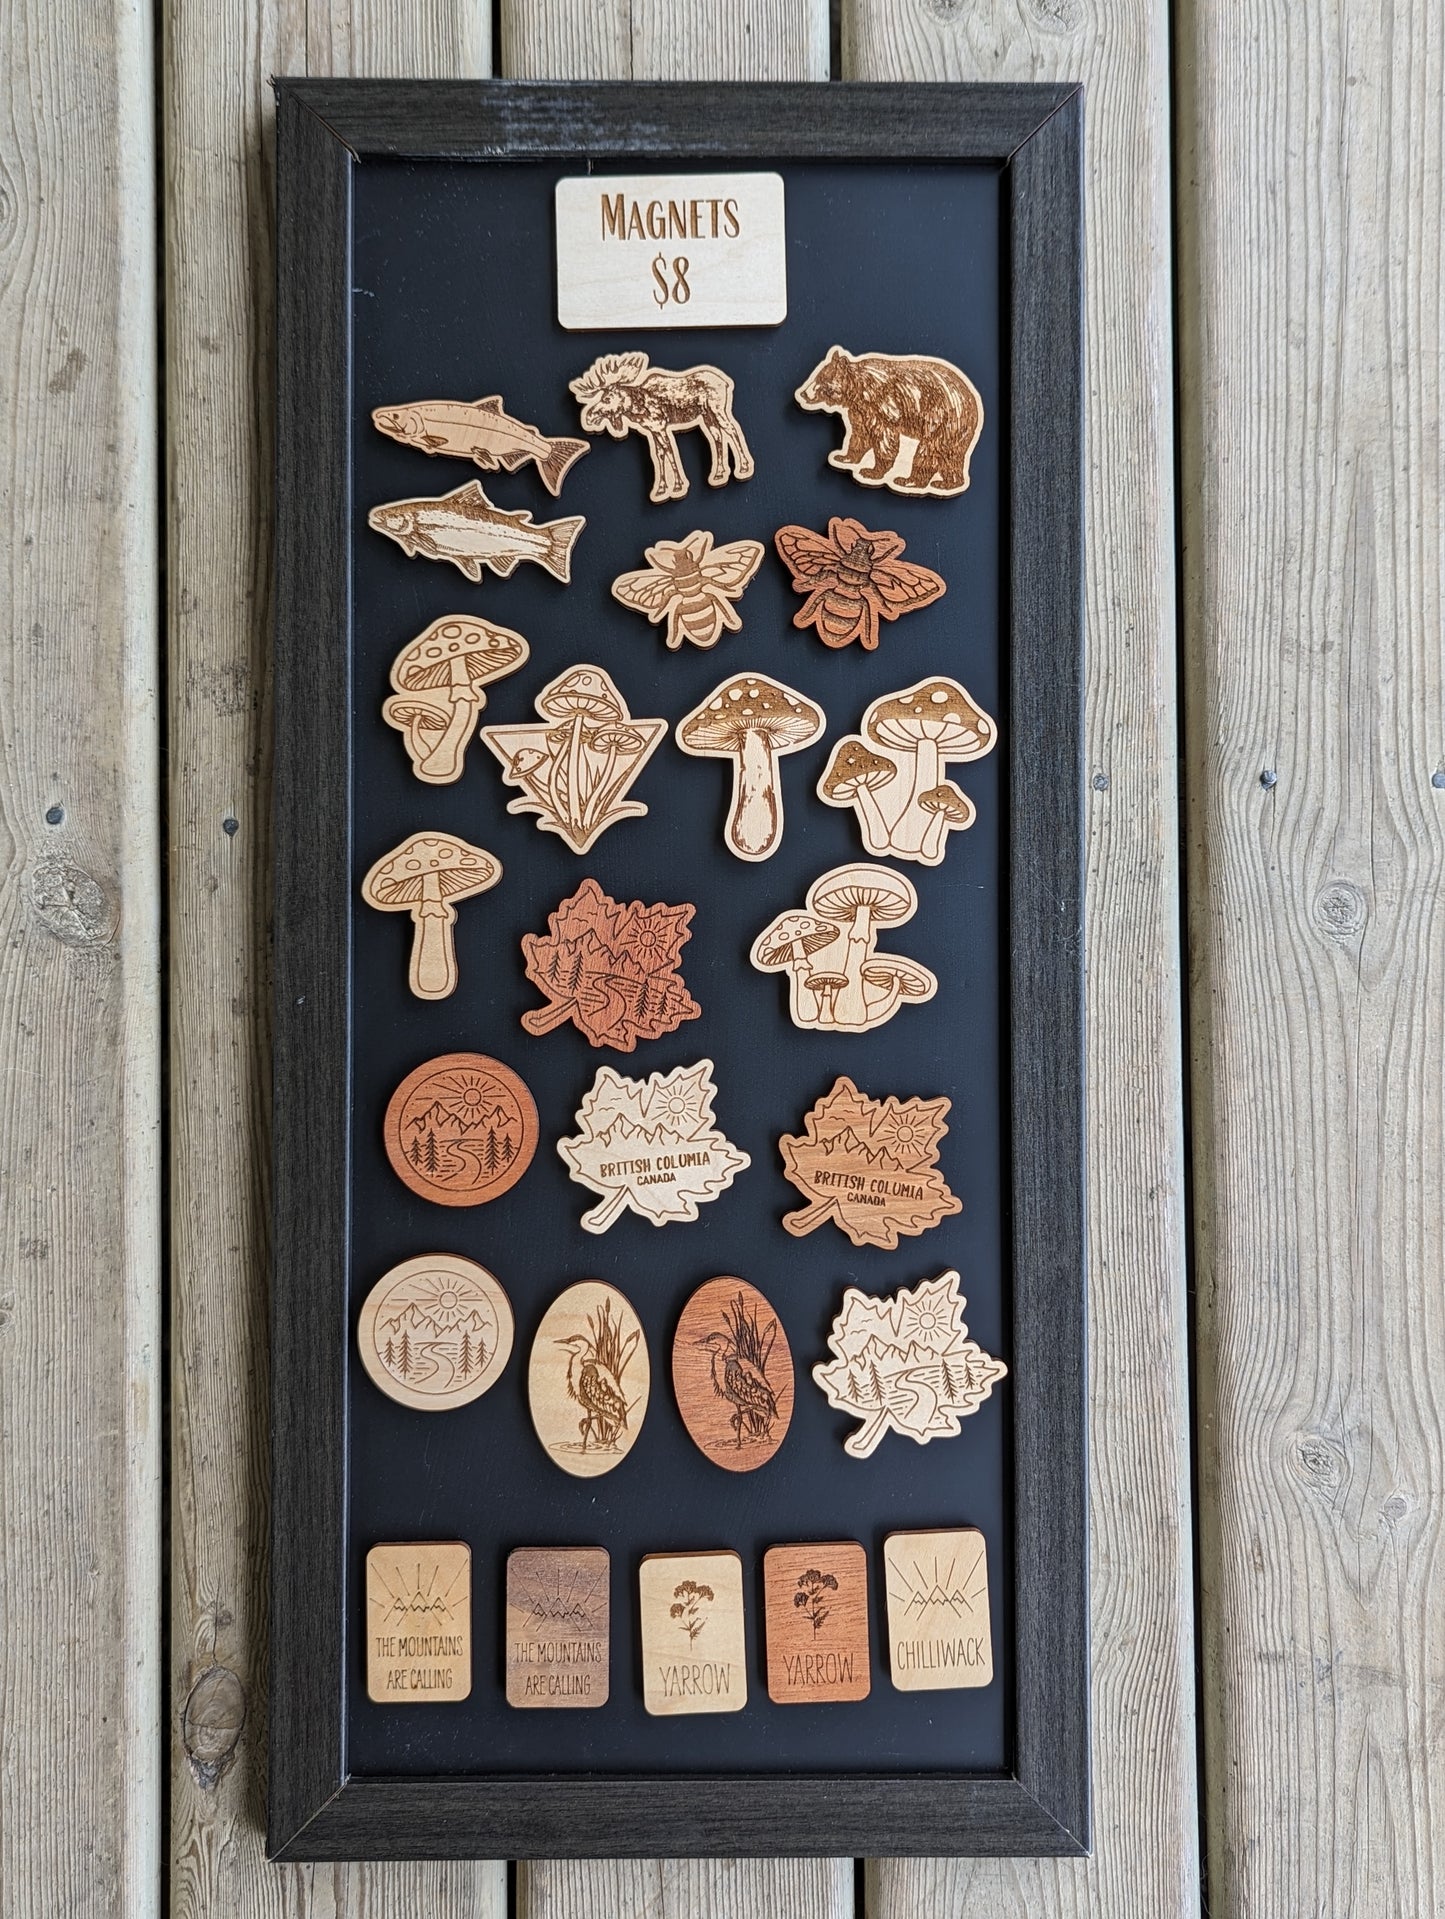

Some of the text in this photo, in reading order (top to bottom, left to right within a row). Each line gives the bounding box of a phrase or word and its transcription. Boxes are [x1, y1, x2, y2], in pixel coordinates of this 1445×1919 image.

[601, 193, 741, 241] MAGNETS
[651, 251, 691, 310] $8
[599, 1151, 711, 1178] BRITISH COLUMIA
[636, 1172, 677, 1186] CANADA
[813, 1170, 924, 1201] BRITISH COLUMIA
[846, 1192, 886, 1208] CANADA
[376, 1635, 463, 1657] THE MOUNTAINS
[514, 1641, 602, 1663] THE MOUNTAINS
[896, 1637, 985, 1671] CHILLIWACK
[386, 1668, 453, 1690] ARE CALLING
[659, 1663, 731, 1697] YARROW
[782, 1652, 854, 1685] YARROW
[525, 1675, 591, 1696] ARE CALLING
